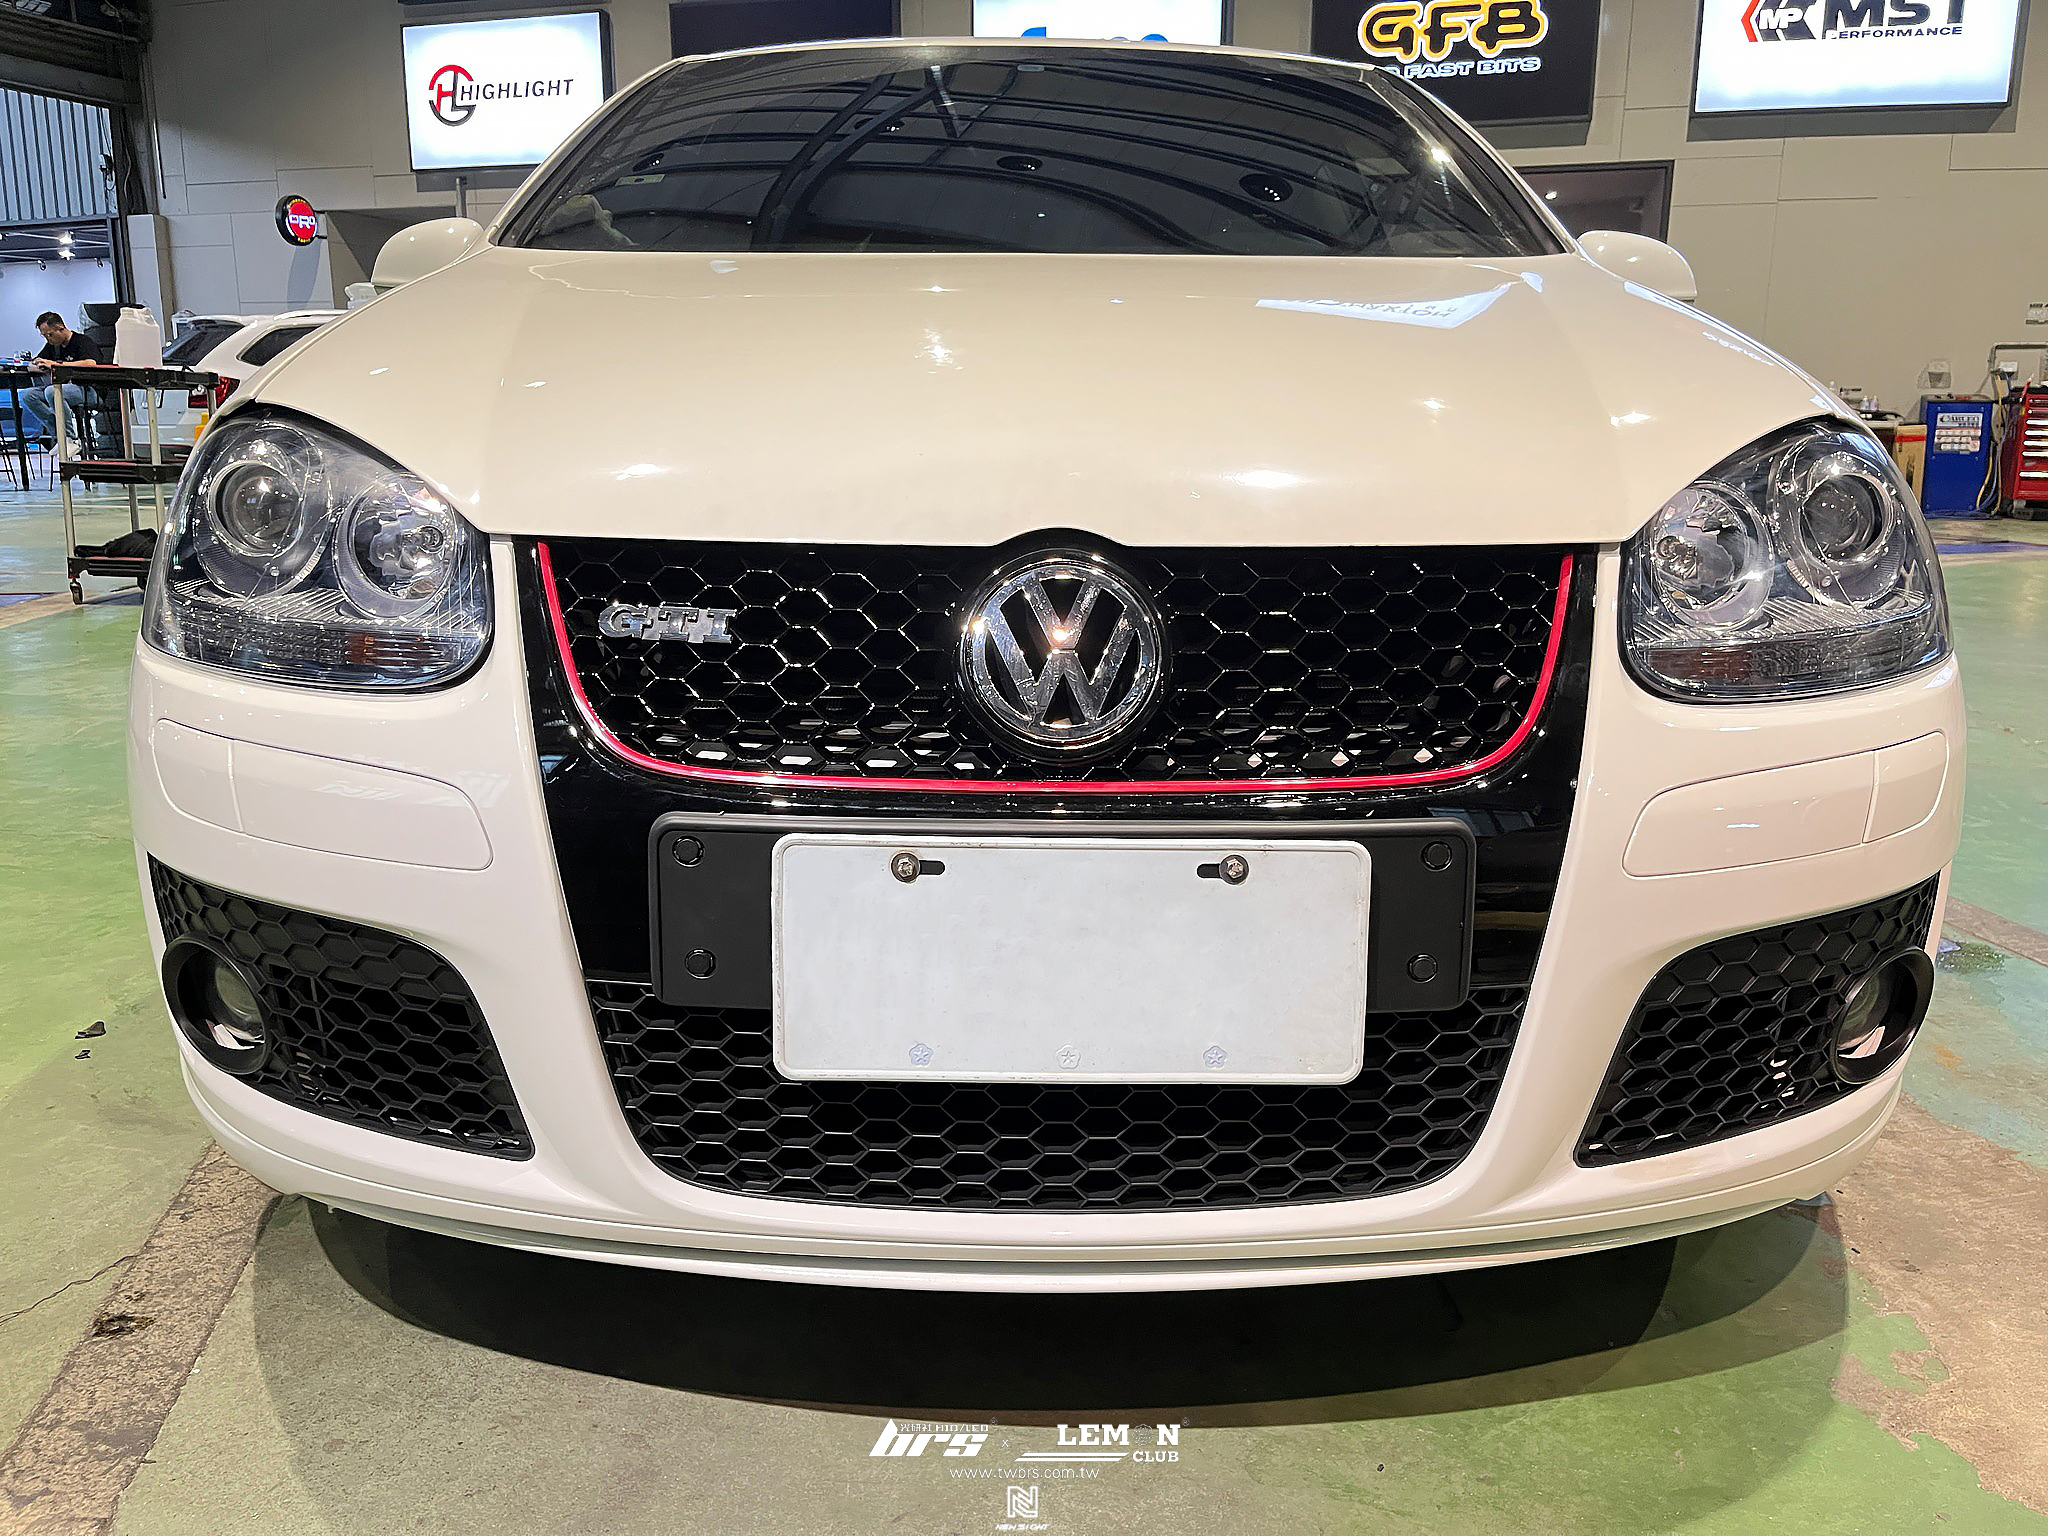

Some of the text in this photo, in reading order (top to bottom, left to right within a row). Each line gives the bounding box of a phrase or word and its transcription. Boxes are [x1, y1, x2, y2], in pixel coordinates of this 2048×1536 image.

[1357, 0, 1549, 64] GFB
[1404, 61, 1474, 79] FAST
[1477, 56, 1542, 75] BITS
[460, 78, 574, 101] HIGHLIGHT
[599, 603, 737, 643] GTI
